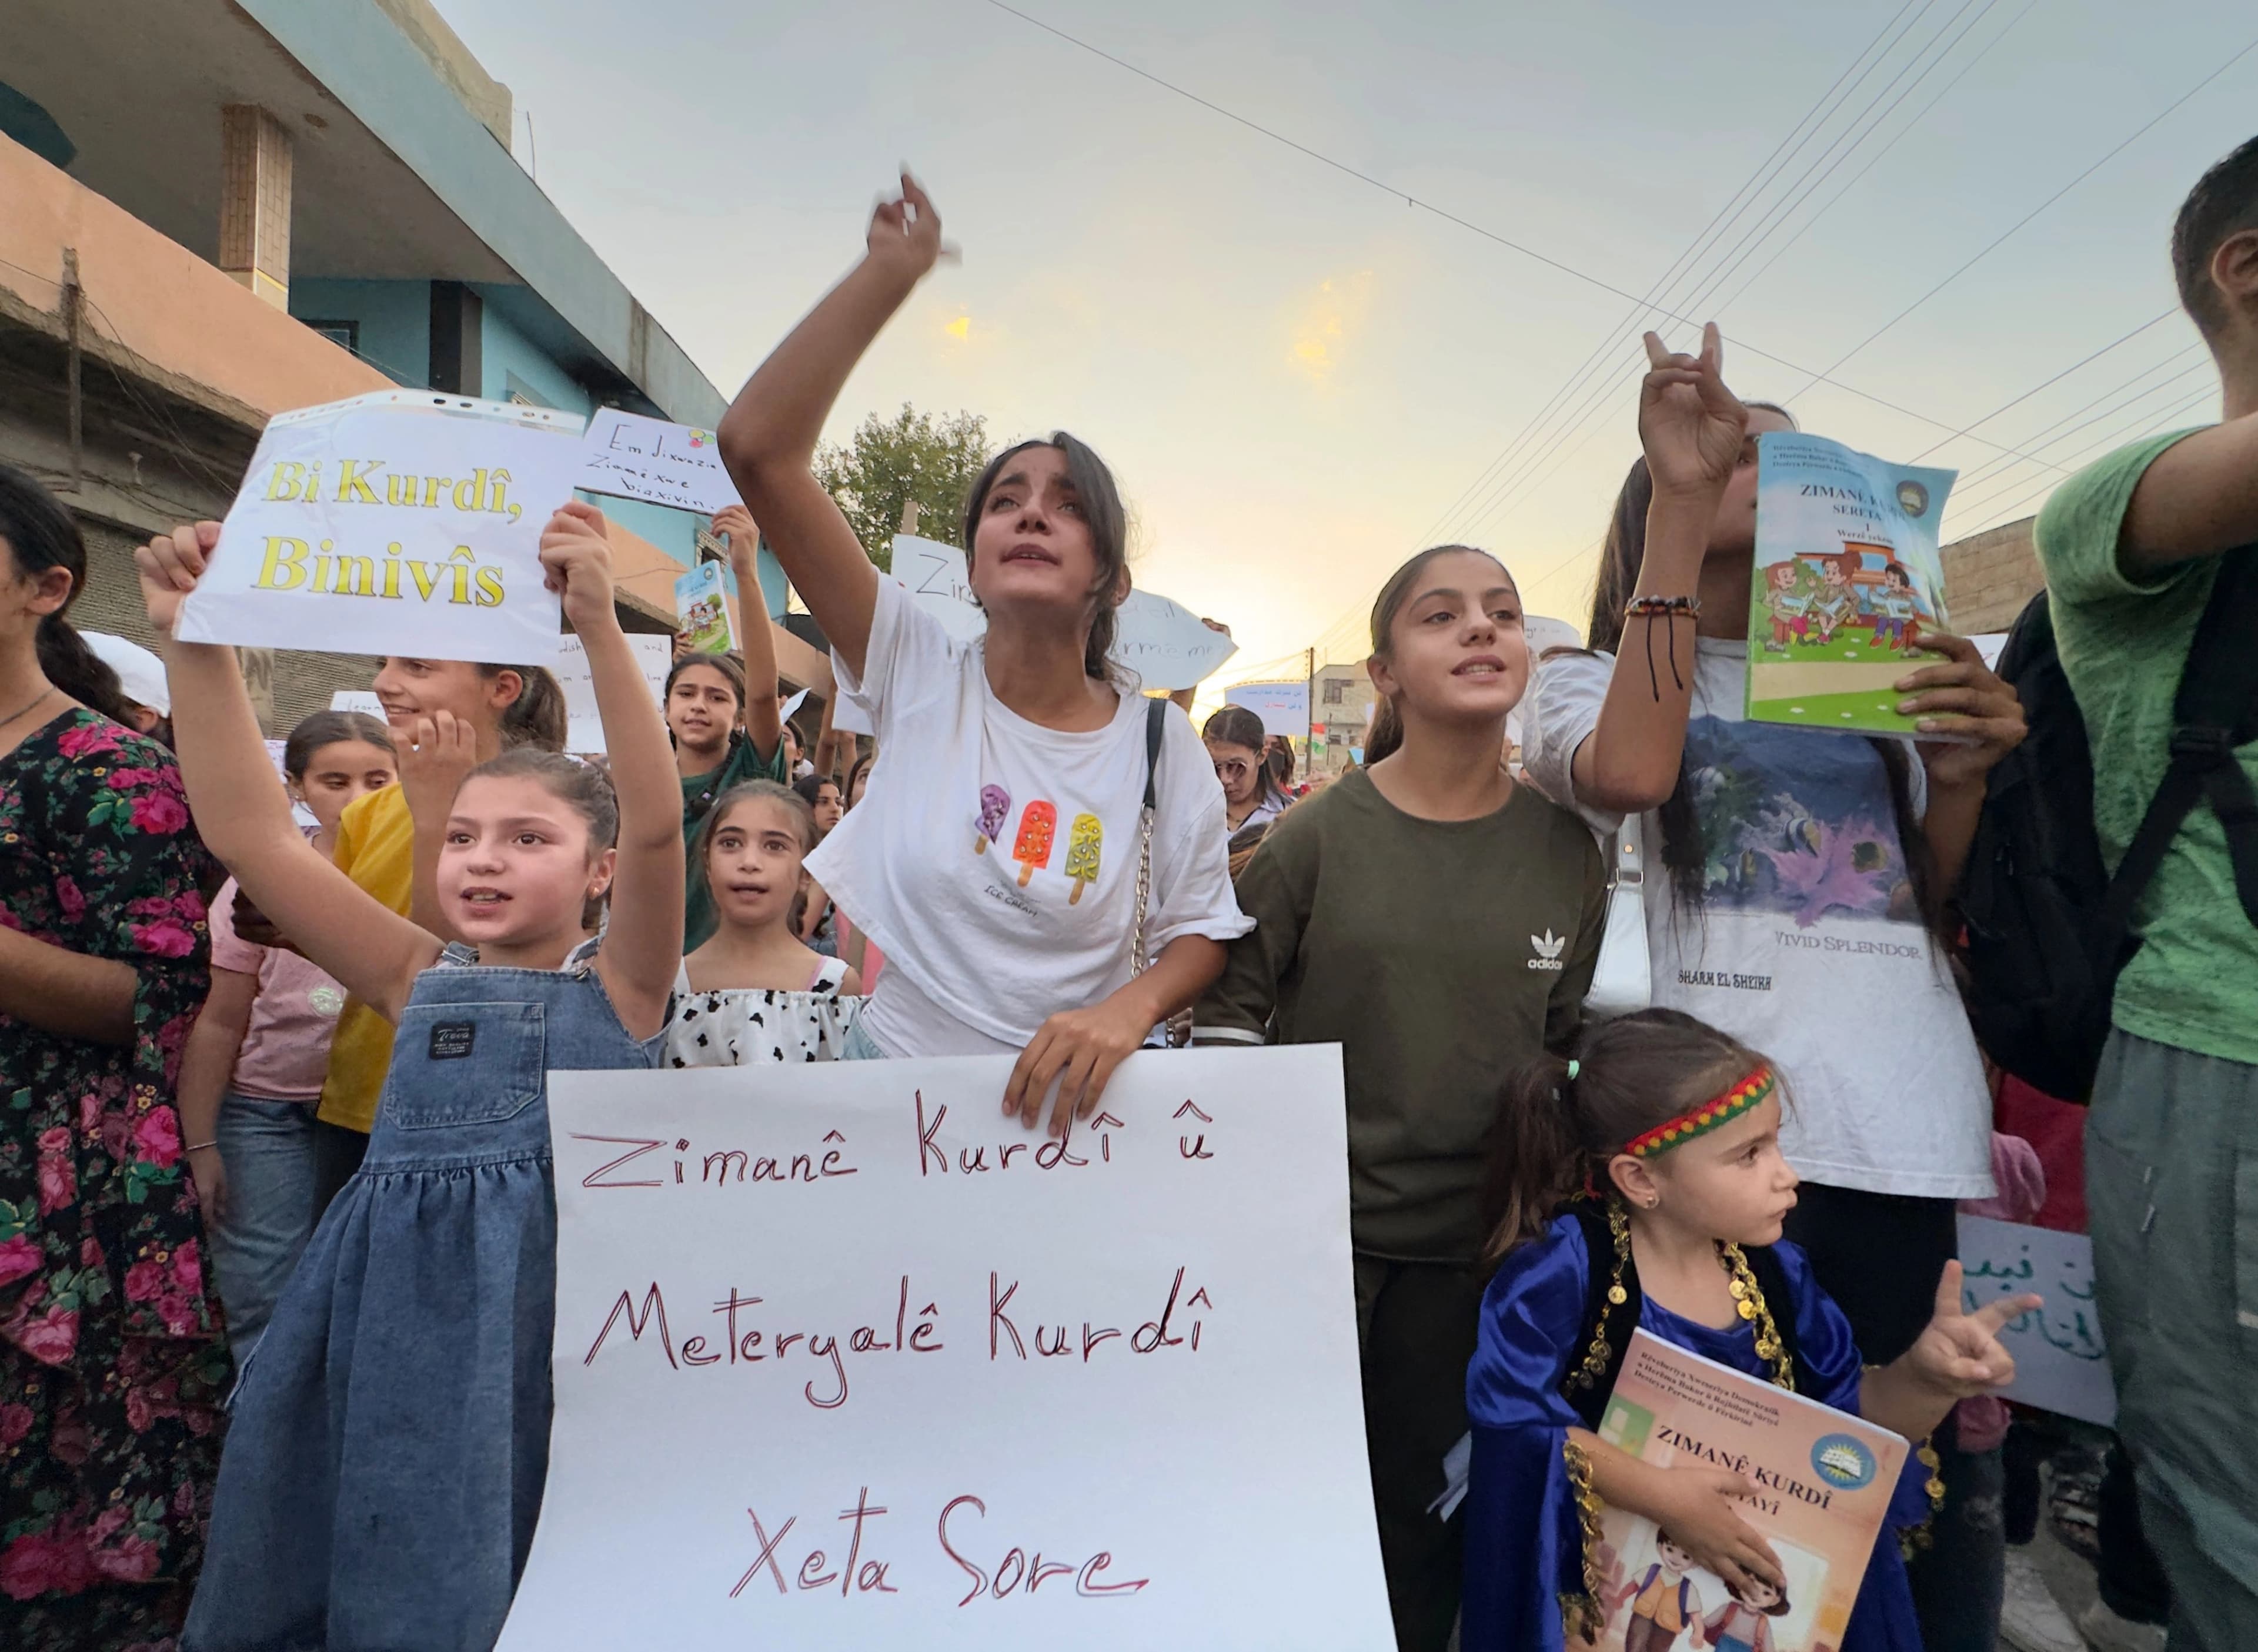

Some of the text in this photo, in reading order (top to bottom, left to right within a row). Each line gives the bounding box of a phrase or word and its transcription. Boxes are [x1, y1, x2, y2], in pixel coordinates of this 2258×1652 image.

[609, 424, 642, 454] Em
[261, 459, 522, 524] Bi Kurdî,
[252, 536, 505, 607] Binivîs
[1528, 959, 1563, 970] adida
[1775, 931, 1821, 949] VIVID
[1678, 969, 1772, 991] SHARM EL SHEIKH
[569, 1089, 1213, 1188] Zimanê Kurdî û
[583, 1266, 1212, 1409] Meteryalê Kurdî
[1657, 1425, 1833, 1510] ZIMANÊ KURDÎ
[730, 1486, 1150, 1608] Xeta Sore
